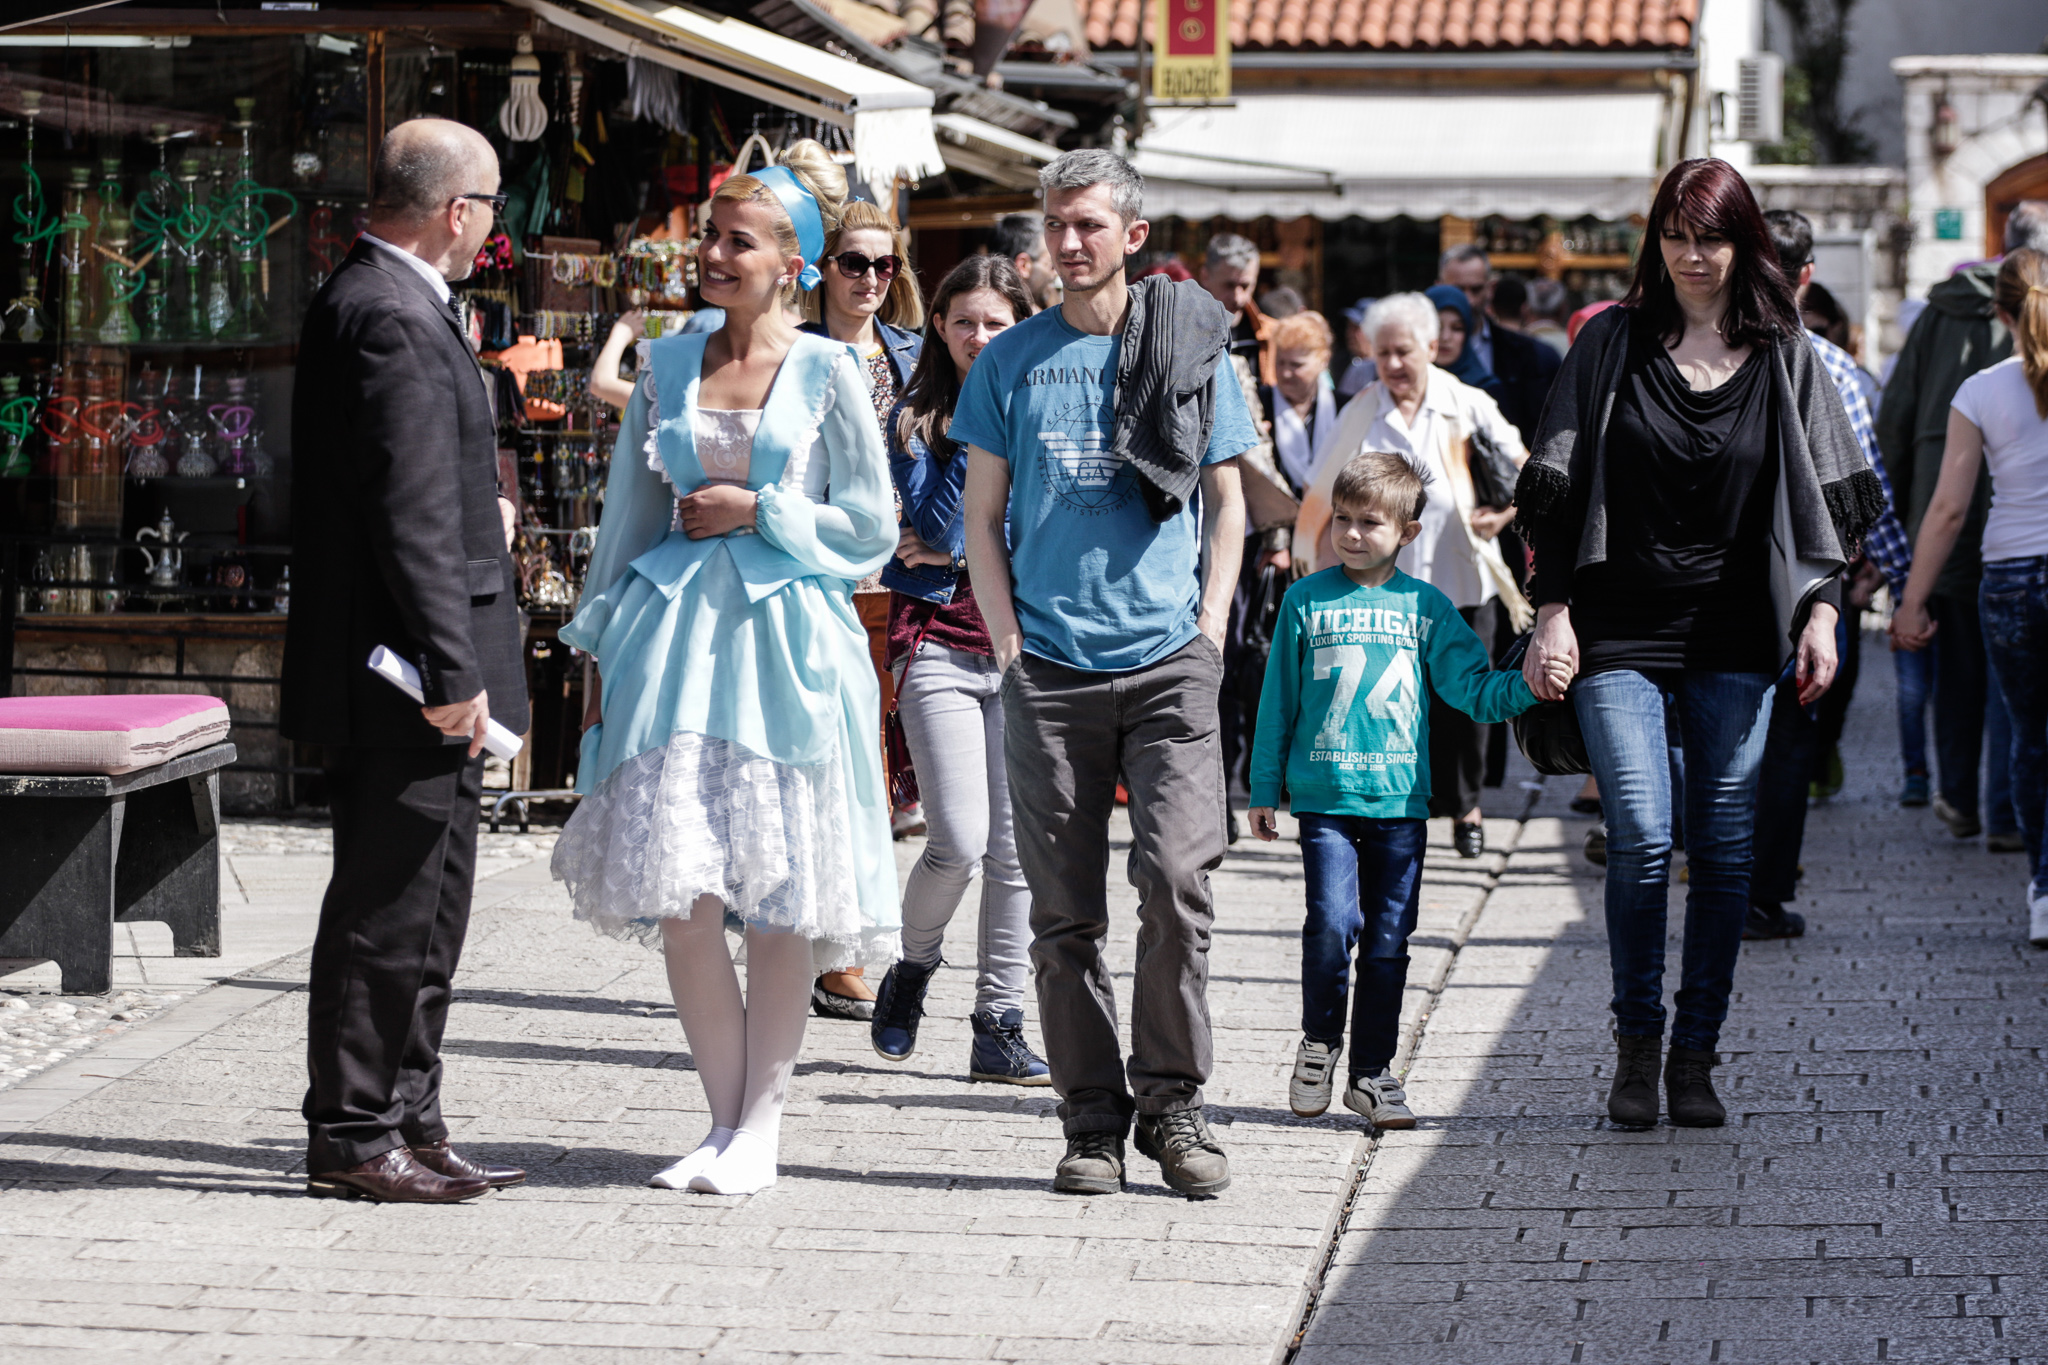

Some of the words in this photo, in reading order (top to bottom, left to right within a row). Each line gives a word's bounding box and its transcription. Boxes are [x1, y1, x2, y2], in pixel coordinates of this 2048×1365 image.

[1019, 367, 1105, 388] ARMANI
[1076, 461, 1110, 482] GA
[1305, 607, 1434, 643] MICHIGAN
[1310, 634, 1345, 647] LUXURY
[1346, 632, 1394, 645] SPORTING
[1313, 644, 1419, 752] 74
[1309, 750, 1384, 764] ESTABLISHED
[1385, 752, 1418, 764] SINCE
